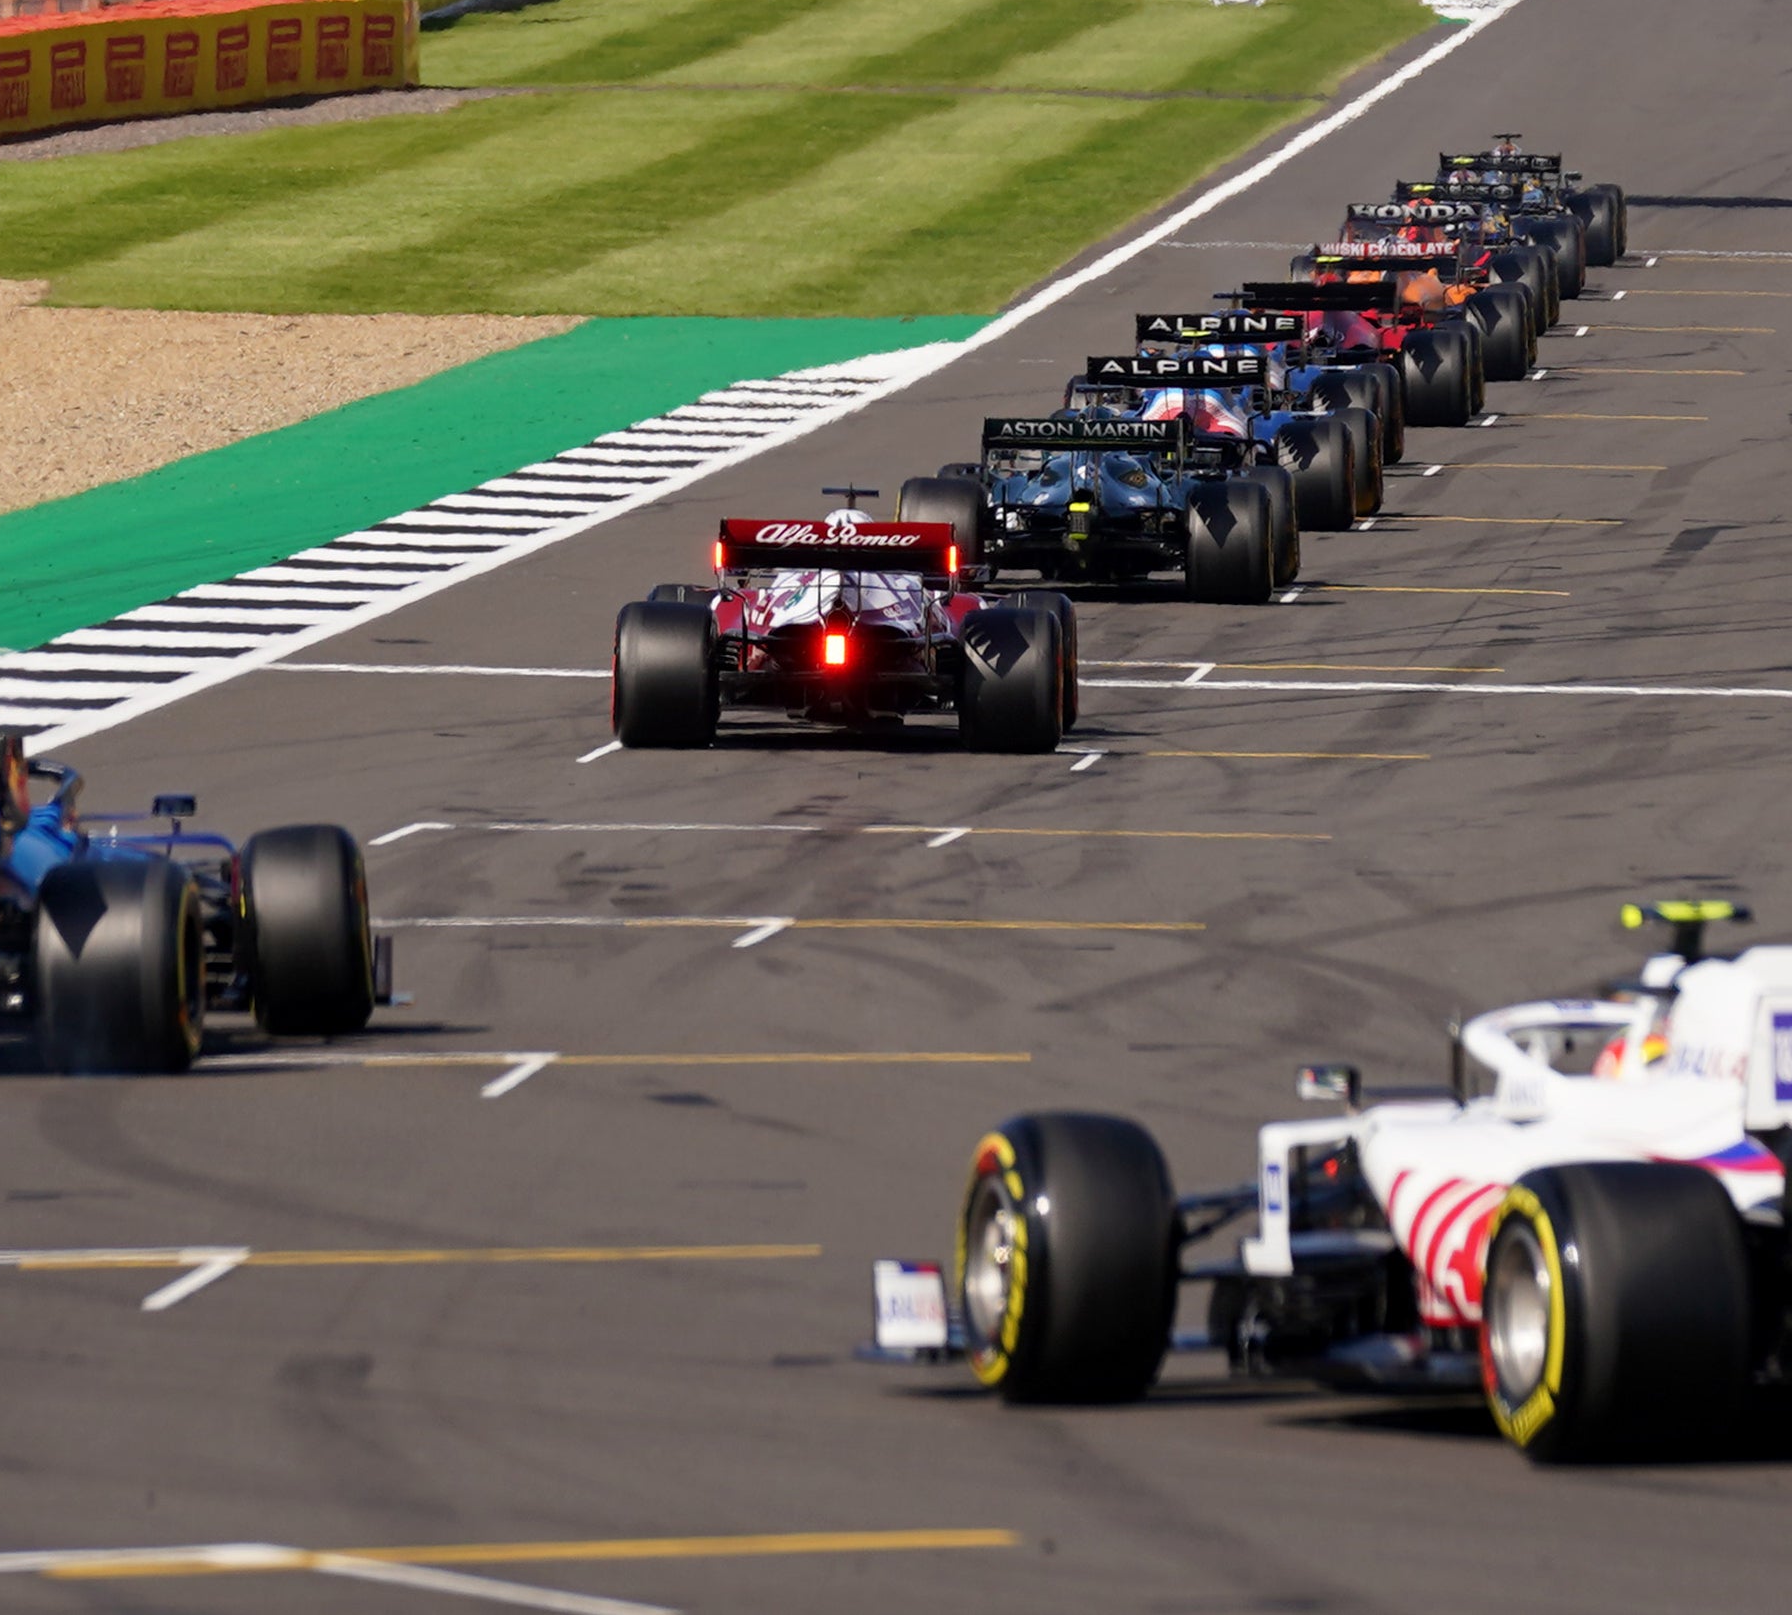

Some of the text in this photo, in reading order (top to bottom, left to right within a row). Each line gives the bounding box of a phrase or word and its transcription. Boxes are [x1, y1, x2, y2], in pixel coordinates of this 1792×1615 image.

[1351, 203, 1477, 220] HONDA
[1318, 242, 1455, 257] HUSKI CHOCOLATE
[1148, 317, 1296, 332] ALPINE
[1099, 359, 1259, 375] ALPINE
[1000, 422, 1167, 437] ASTON MARTIN
[755, 523, 922, 547] Alfa Romeo
